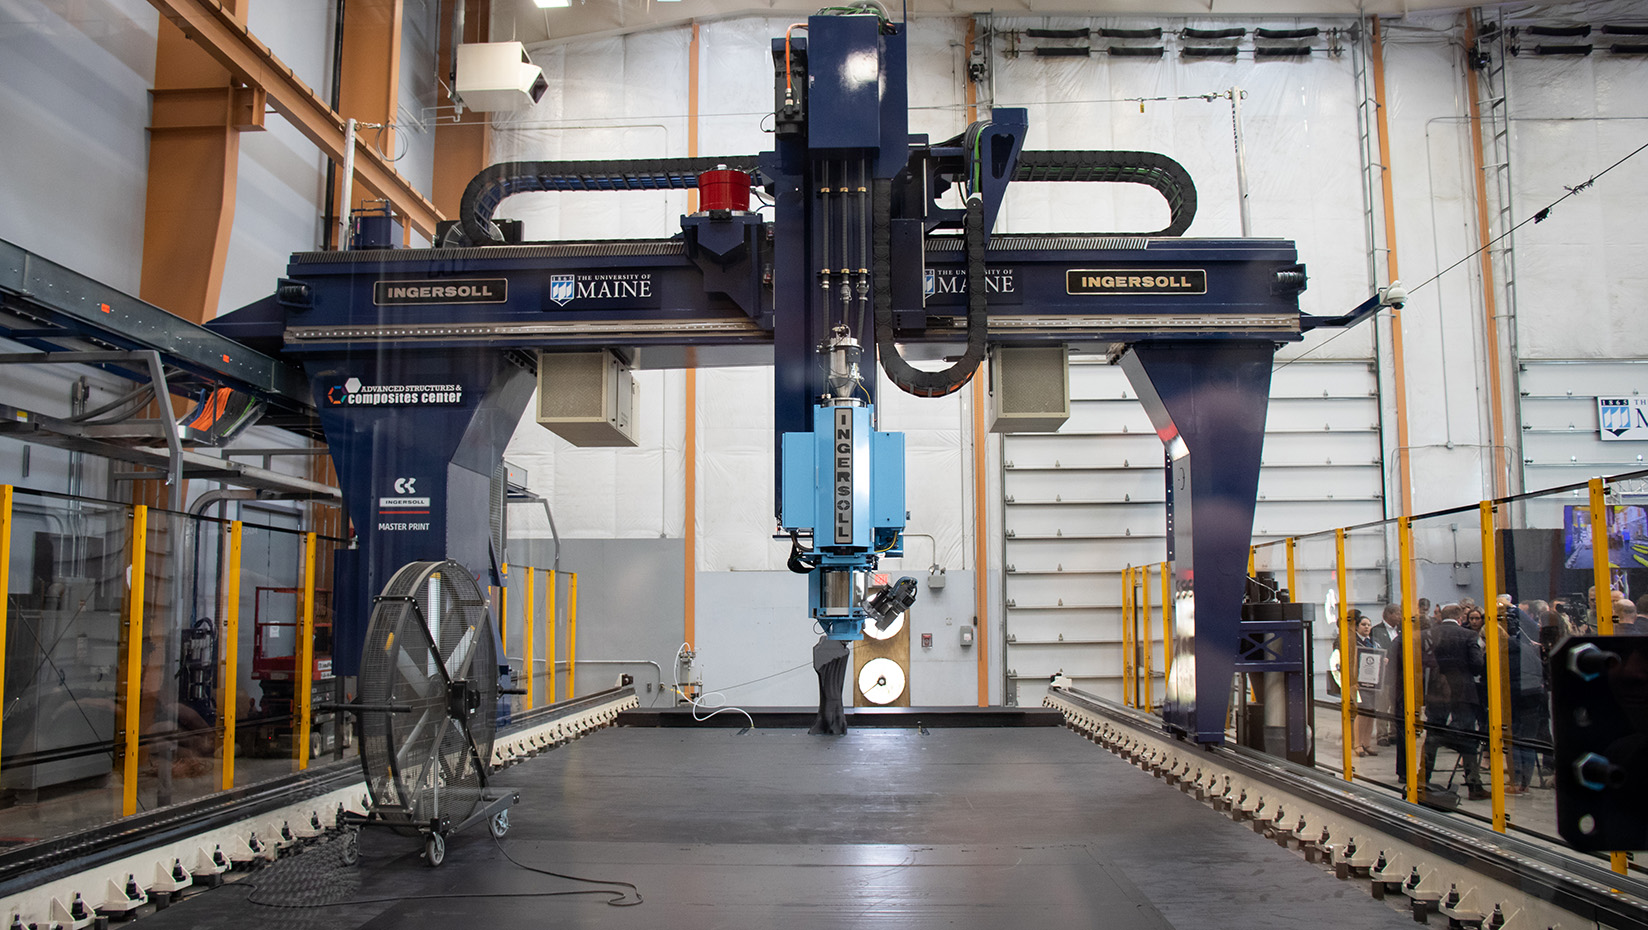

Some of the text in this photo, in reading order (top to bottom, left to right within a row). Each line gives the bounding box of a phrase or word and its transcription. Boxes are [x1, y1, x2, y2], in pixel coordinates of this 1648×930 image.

[937, 276, 1015, 294] MNE
[1081, 276, 1192, 288] INGERSOLL
[387, 285, 493, 298] INGERSOLL
[576, 281, 652, 299] MAINE
[361, 384, 462, 393] ADVANCED STRUCTURES &
[347, 392, 462, 405] composites center
[837, 414, 851, 538] INGERSOLL
[378, 522, 430, 531] MASTER PRINT
